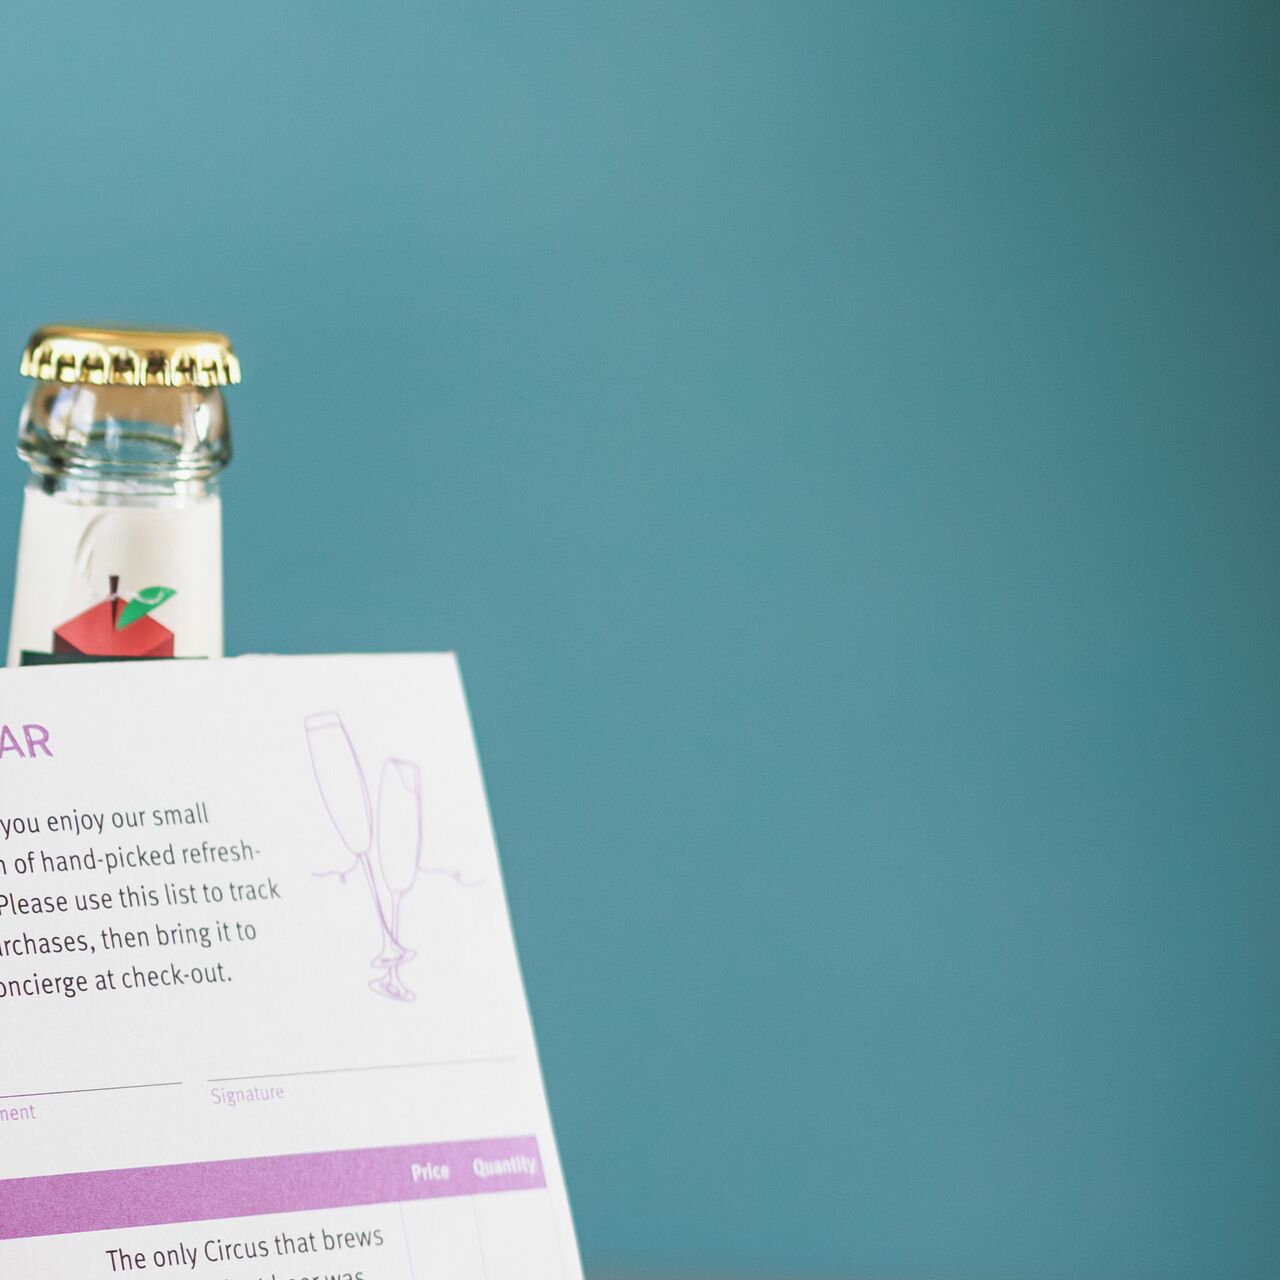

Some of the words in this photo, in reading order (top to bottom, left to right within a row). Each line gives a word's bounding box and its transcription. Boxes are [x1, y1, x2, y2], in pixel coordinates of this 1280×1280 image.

[0, 817, 40, 840] you
[47, 809, 104, 836] enjoy
[112, 811, 145, 828] our
[153, 802, 208, 826] small
[15, 851, 34, 874] of
[40, 843, 175, 874] hand-picked
[182, 840, 259, 864] refresh-
[75, 893, 112, 911] use
[119, 885, 159, 908] this
[165, 883, 197, 905] list
[203, 884, 223, 903] to
[230, 878, 280, 901] track
[101, 927, 149, 949] then
[156, 923, 211, 948] bring
[216, 921, 231, 942] it
[236, 922, 256, 941] to
[95, 970, 116, 990] at
[122, 963, 231, 988] check-out.
[211, 1086, 285, 1106] Signature
[410, 1161, 450, 1182] Price
[472, 1154, 536, 1179] Quantity
[105, 1248, 146, 1271] The
[154, 1242, 197, 1270] only
[204, 1239, 269, 1262] Circus
[274, 1232, 317, 1255] that
[322, 1229, 383, 1250] brews
